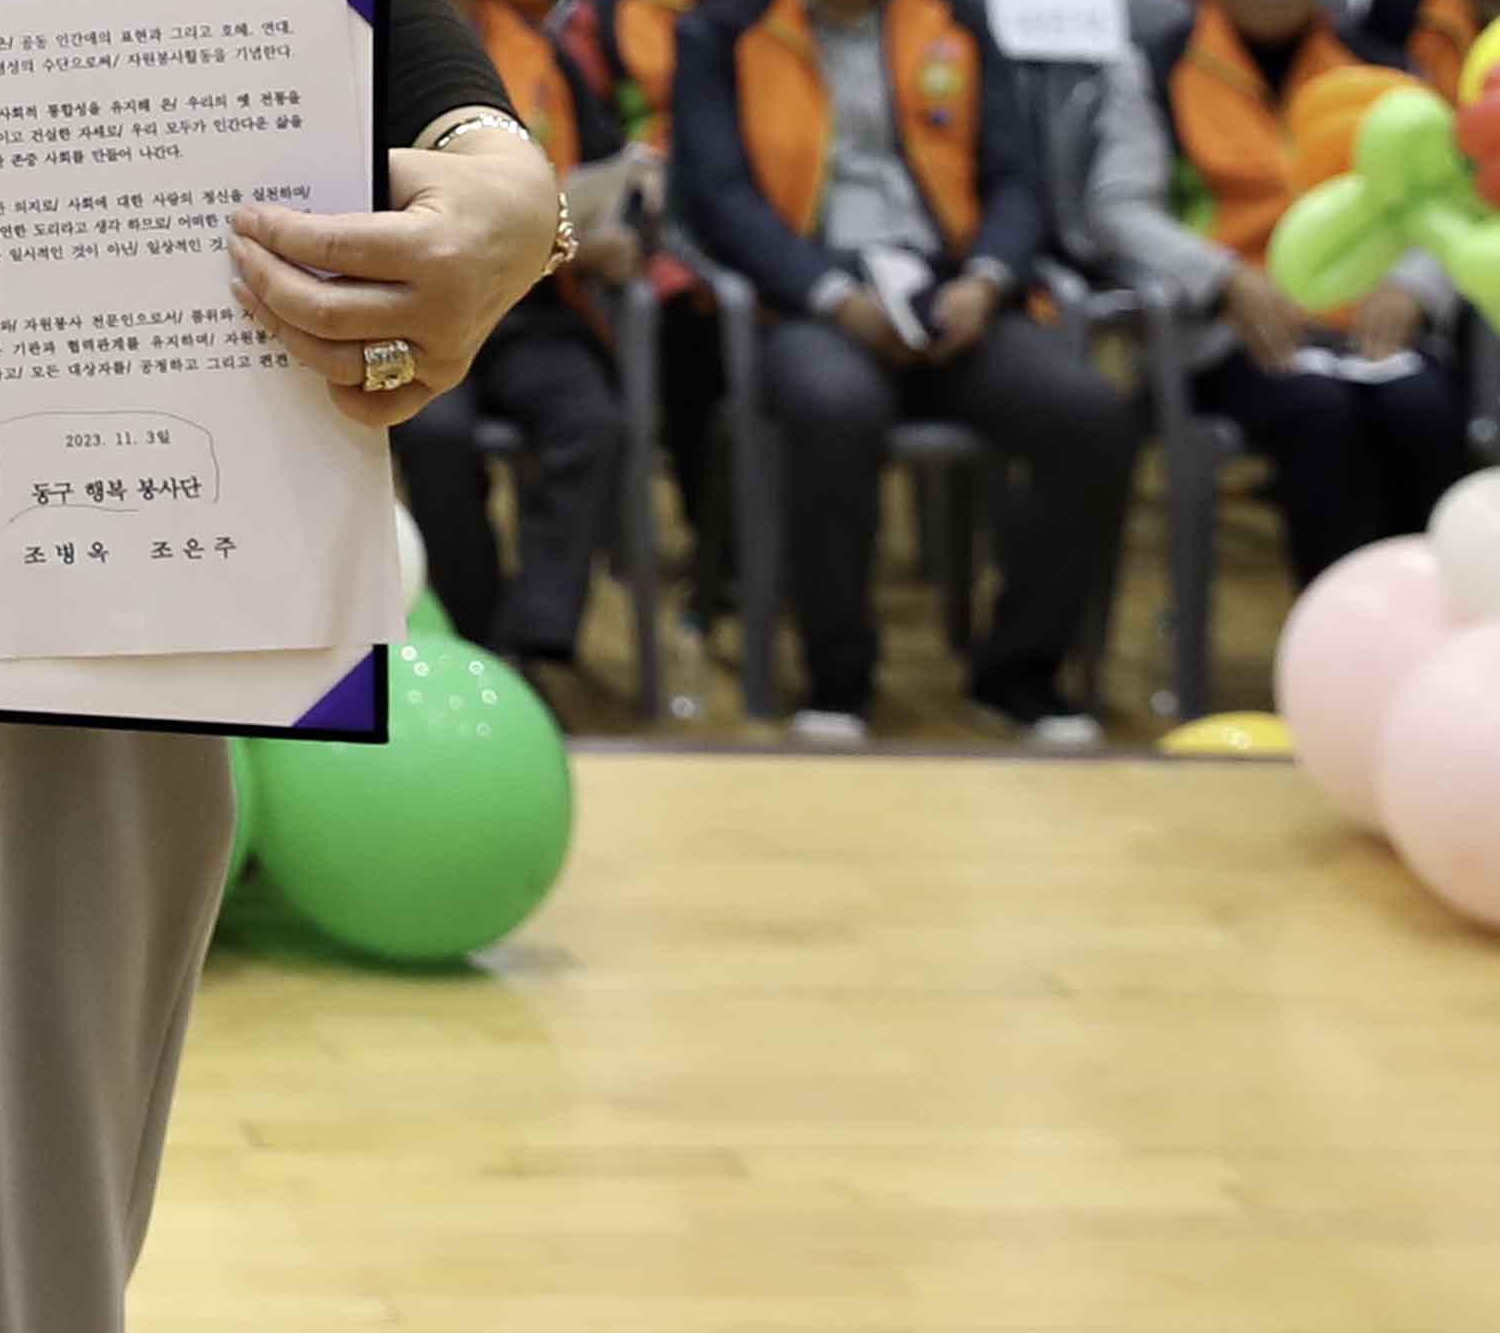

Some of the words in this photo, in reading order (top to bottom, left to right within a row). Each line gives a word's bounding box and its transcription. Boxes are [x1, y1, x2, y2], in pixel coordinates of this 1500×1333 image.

[31, 482, 75, 502] 동구
[84, 479, 128, 500] 행복
[137, 475, 202, 497] 봉사단
